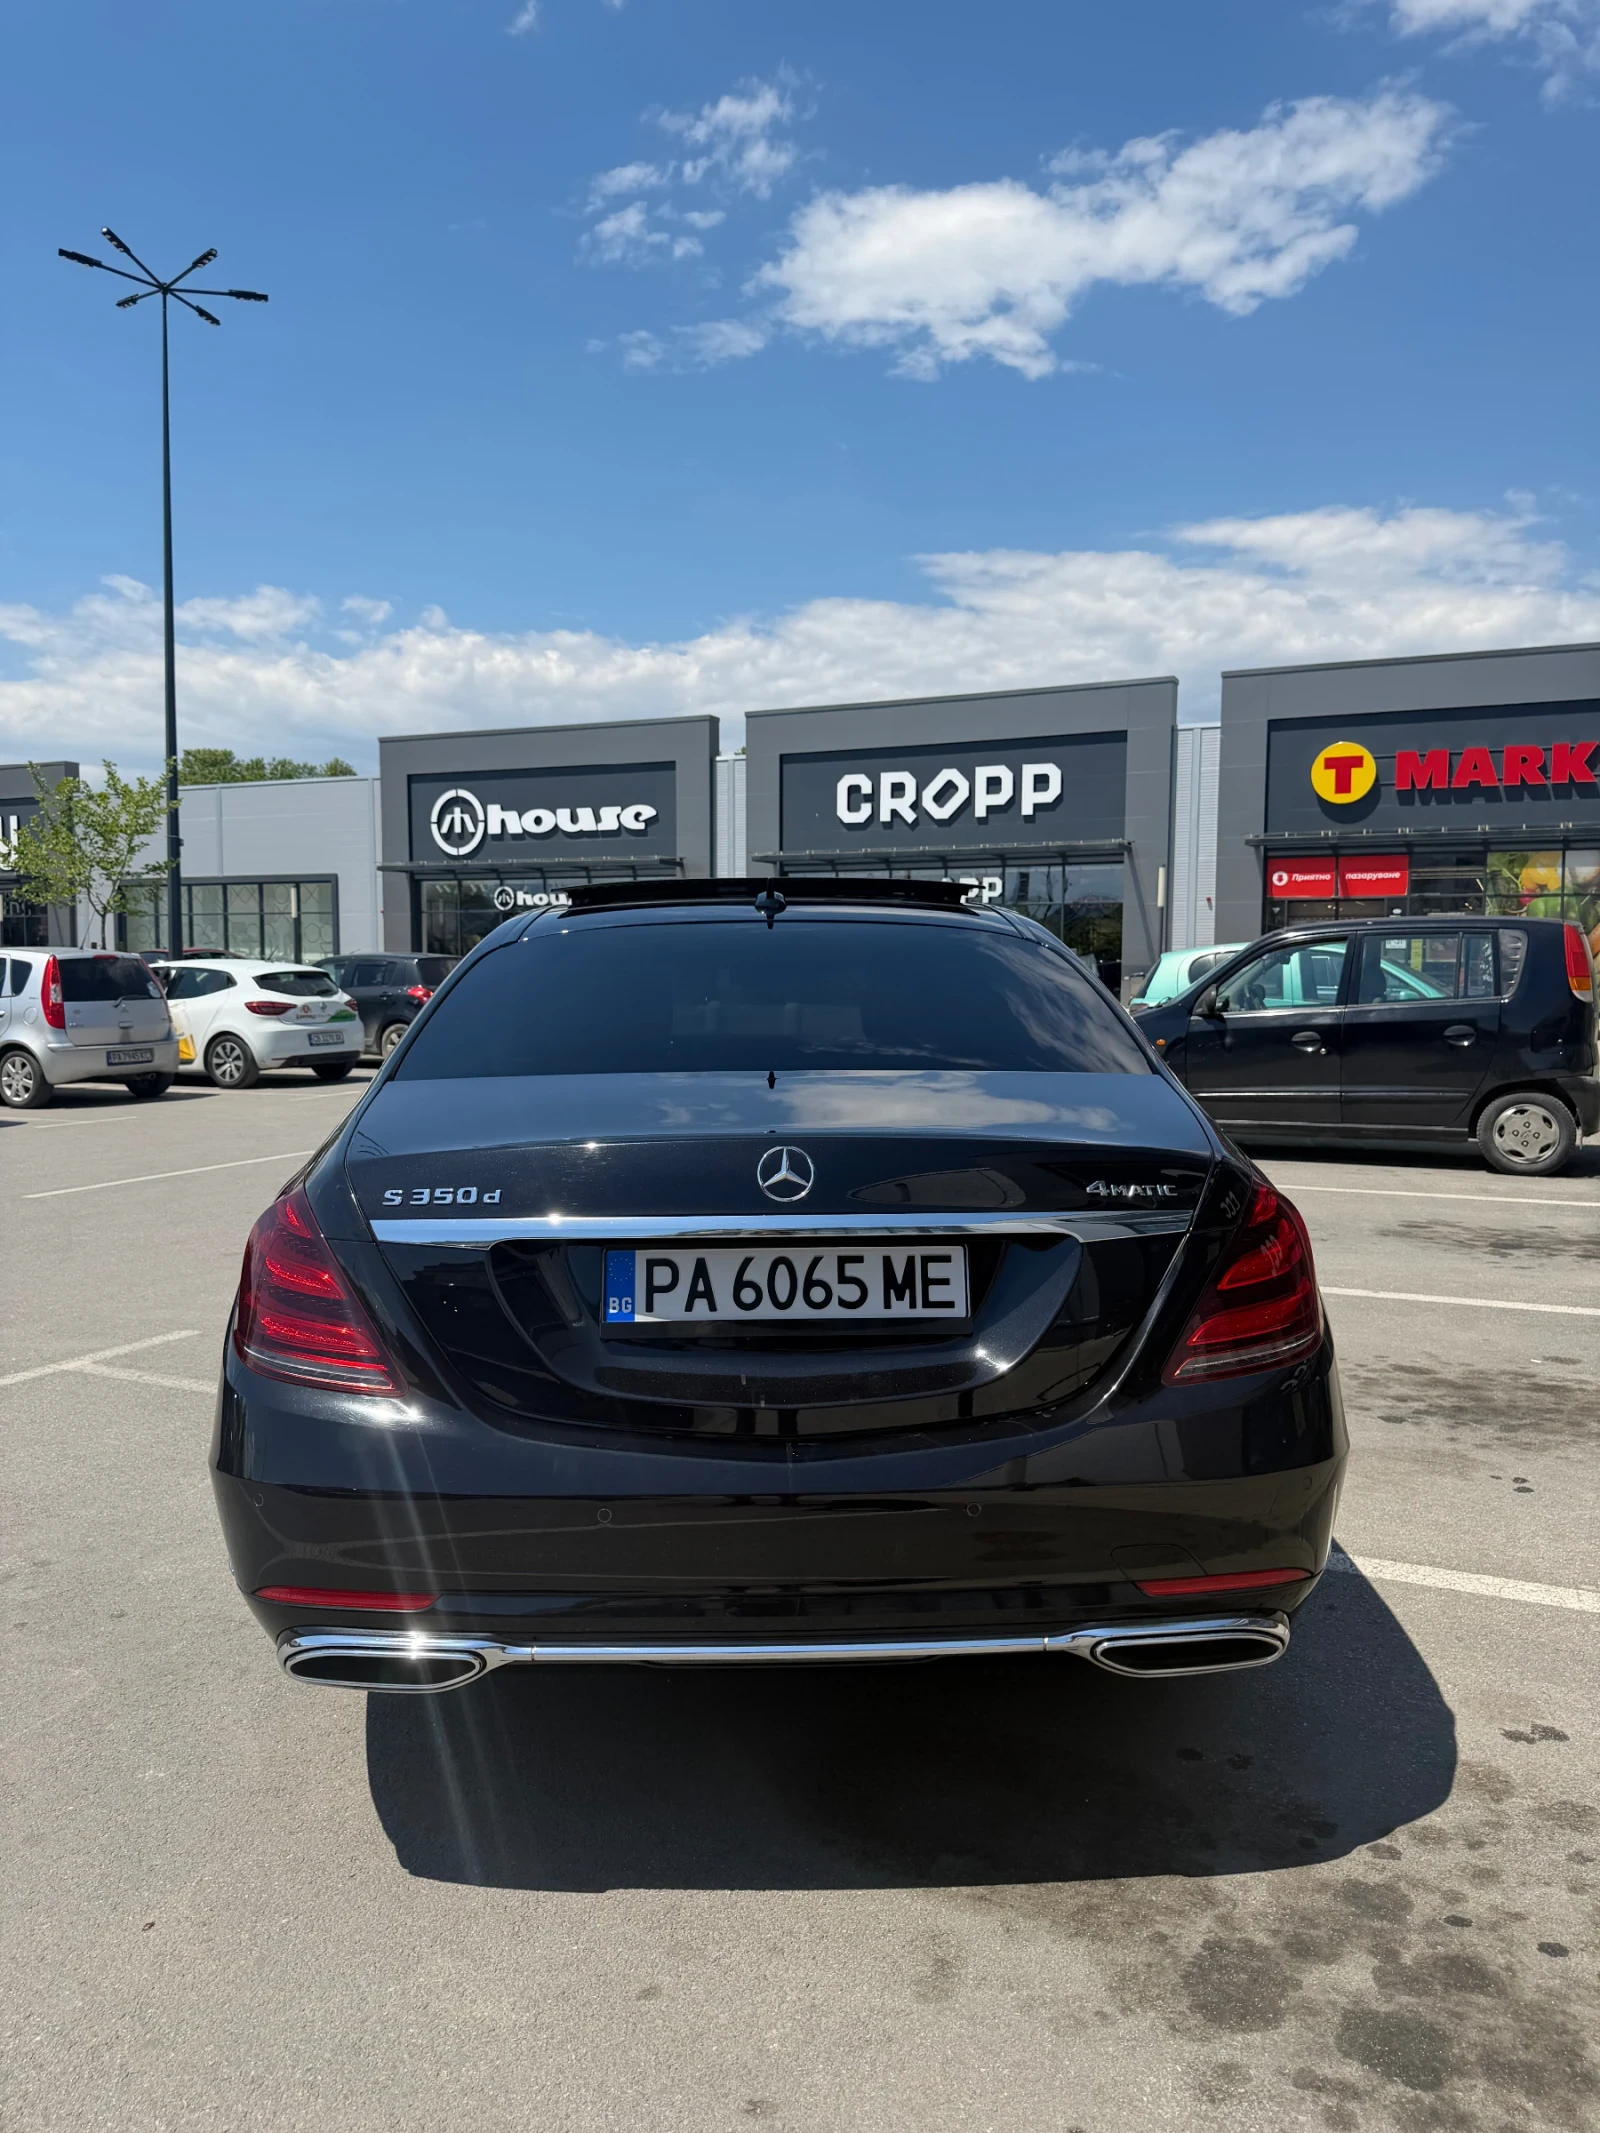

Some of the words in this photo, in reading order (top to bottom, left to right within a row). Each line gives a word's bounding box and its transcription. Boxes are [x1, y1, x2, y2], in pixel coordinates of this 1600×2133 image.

[1324, 755, 1364, 794] T
[1395, 741, 1599, 790] MARK
[837, 763, 1062, 824] CROPP
[487, 804, 657, 834] house
[1291, 873, 1332, 882] Приятно
[1345, 872, 1401, 881] пазаруване
[516, 891, 573, 906] hou
[382, 1189, 403, 1206] S
[410, 1187, 478, 1205] 350
[483, 1189, 502, 1204] d
[1086, 1180, 1178, 1197] 4MATIC
[645, 1256, 718, 1313] PA
[732, 1255, 868, 1312] 6065
[882, 1255, 956, 1310] ME
[608, 1297, 632, 1314] BG
